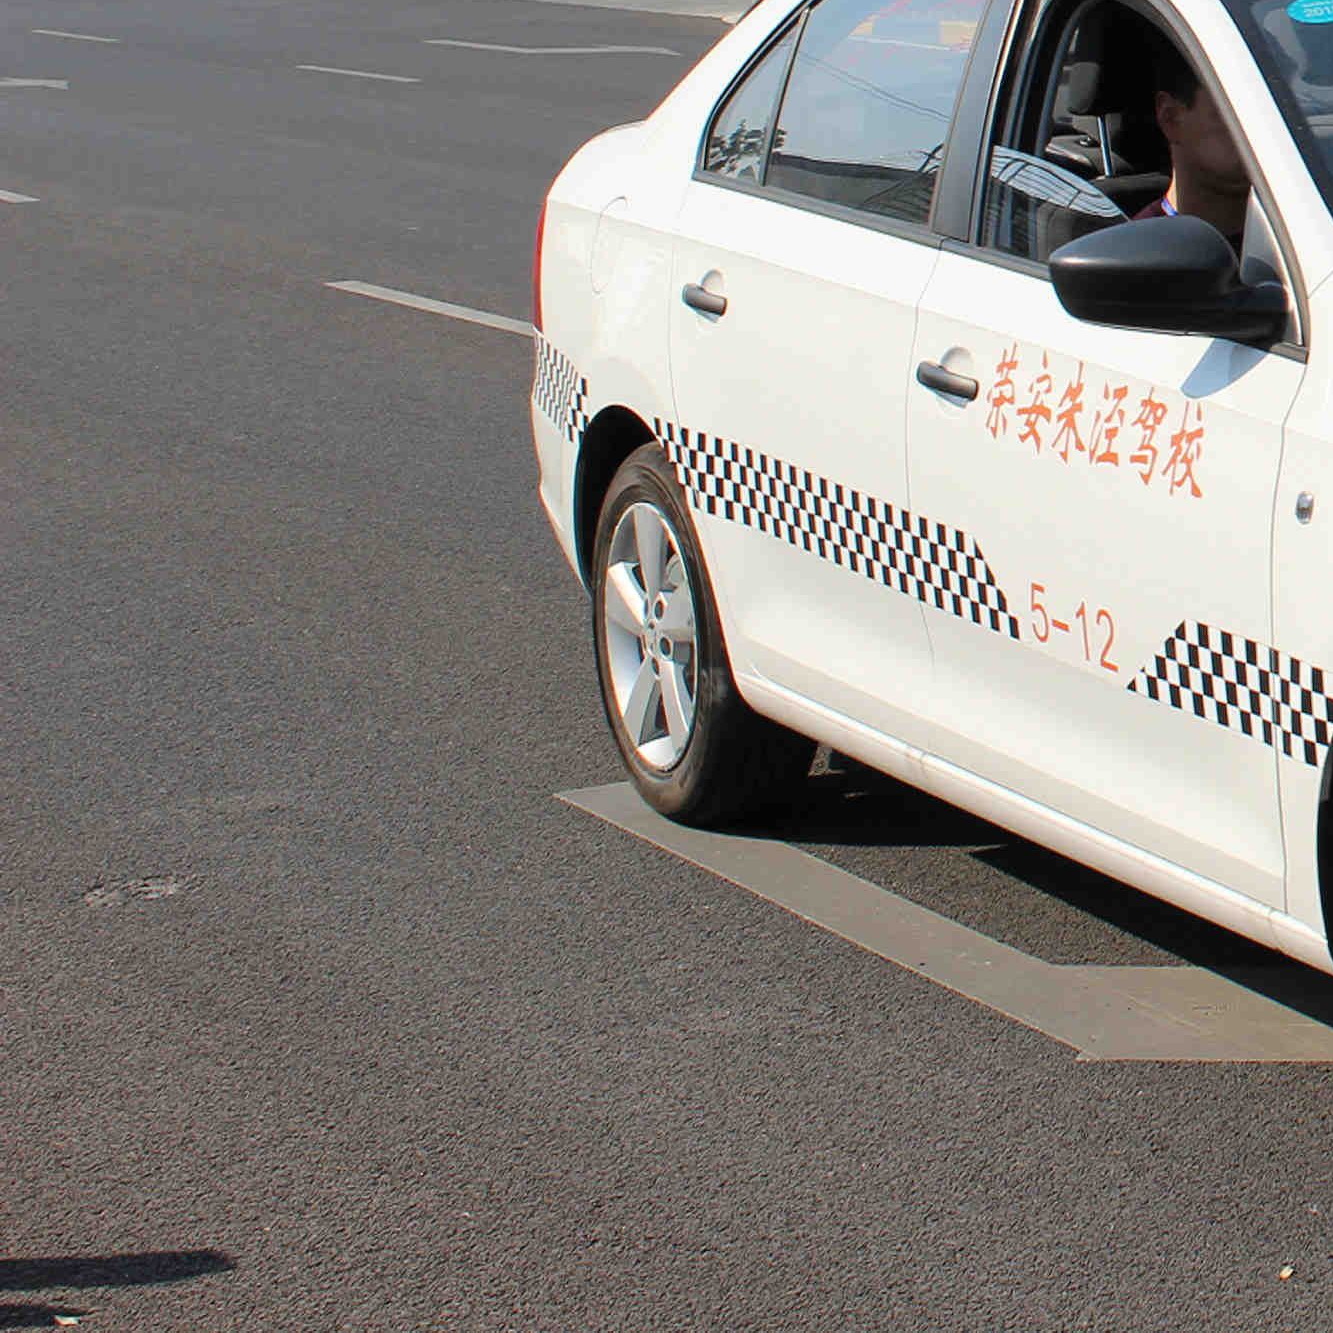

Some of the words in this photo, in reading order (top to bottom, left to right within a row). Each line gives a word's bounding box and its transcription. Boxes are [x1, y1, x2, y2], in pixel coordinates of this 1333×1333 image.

[986, 343, 1204, 498] 荣安朱泾驾校
[1031, 583, 1118, 672] 5-12
